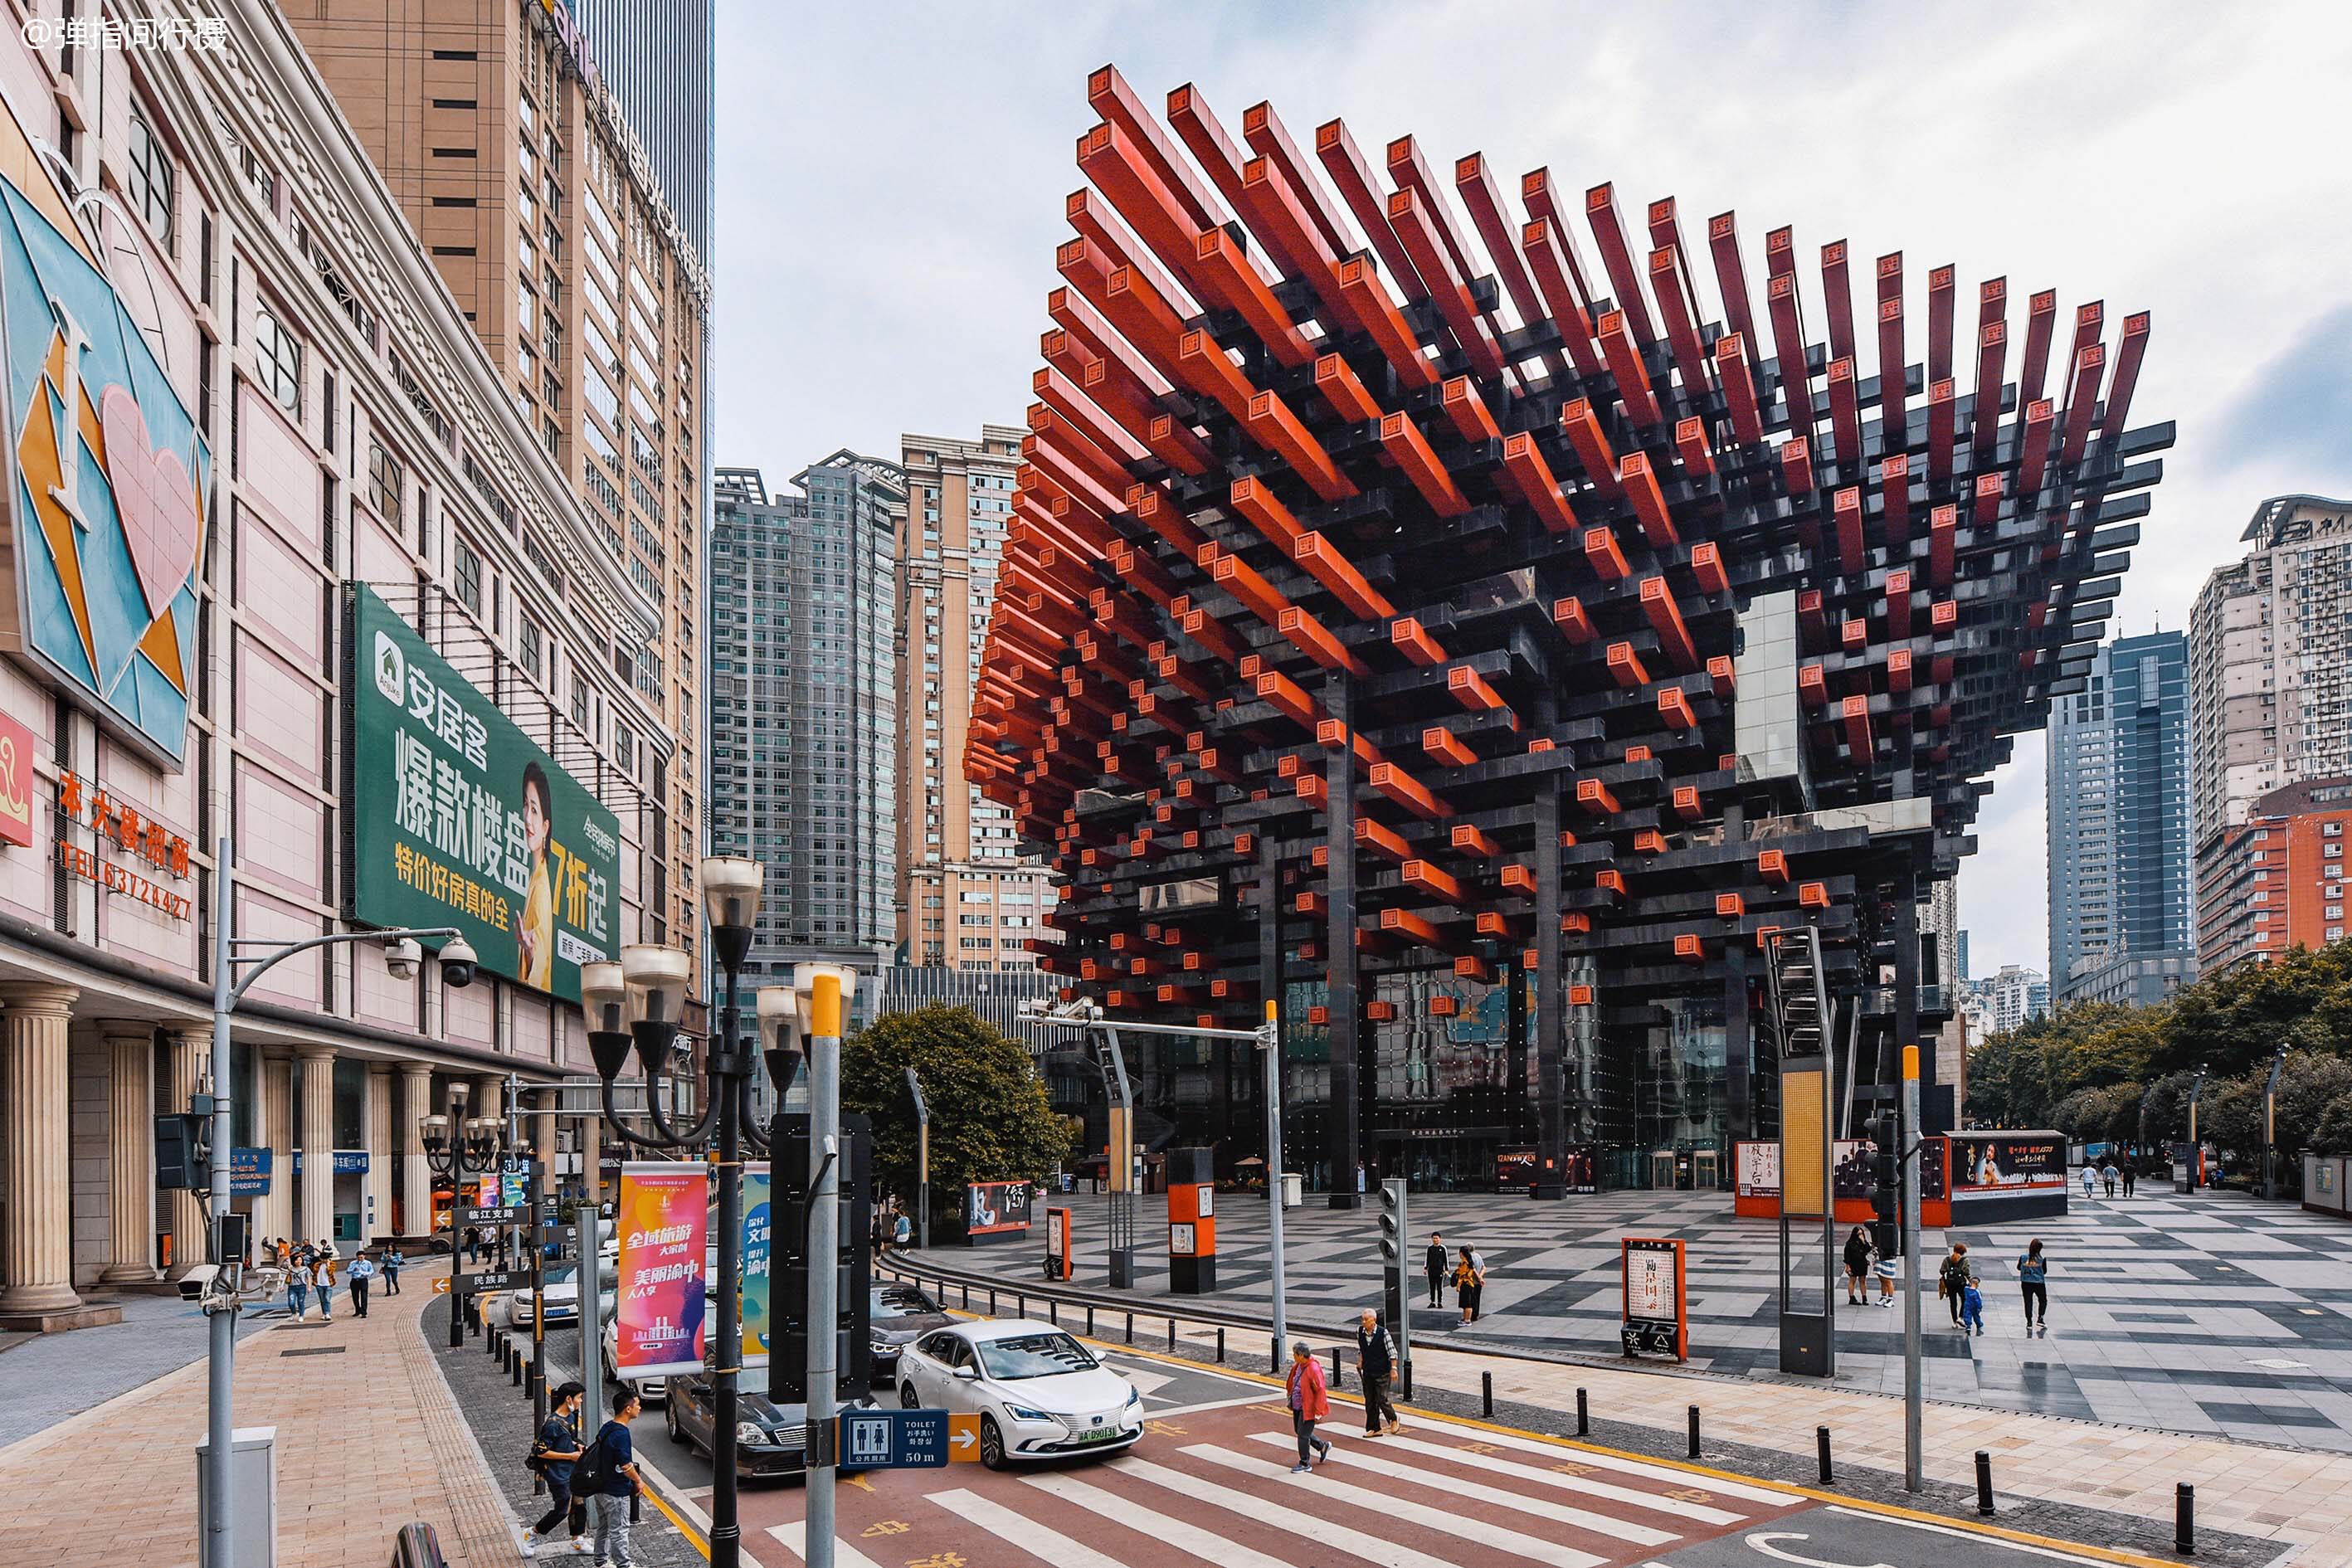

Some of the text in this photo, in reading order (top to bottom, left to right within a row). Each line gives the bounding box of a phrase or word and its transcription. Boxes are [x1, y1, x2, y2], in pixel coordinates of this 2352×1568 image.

[407, 663, 488, 772] 安居客
[394, 726, 531, 898] 爆款楼盘
[59, 840, 100, 881] TEL
[395, 841, 509, 933] 特价好房真的全
[550, 838, 607, 943] 7折起
[468, 1209, 514, 1220] 临江支路
[626, 1224, 693, 1250] 全域旅游
[474, 1274, 509, 1285] 民族路
[633, 1259, 699, 1287] 美丽渝中
[627, 1285, 657, 1300] 人人享
[905, 1453, 934, 1463] 50 m
